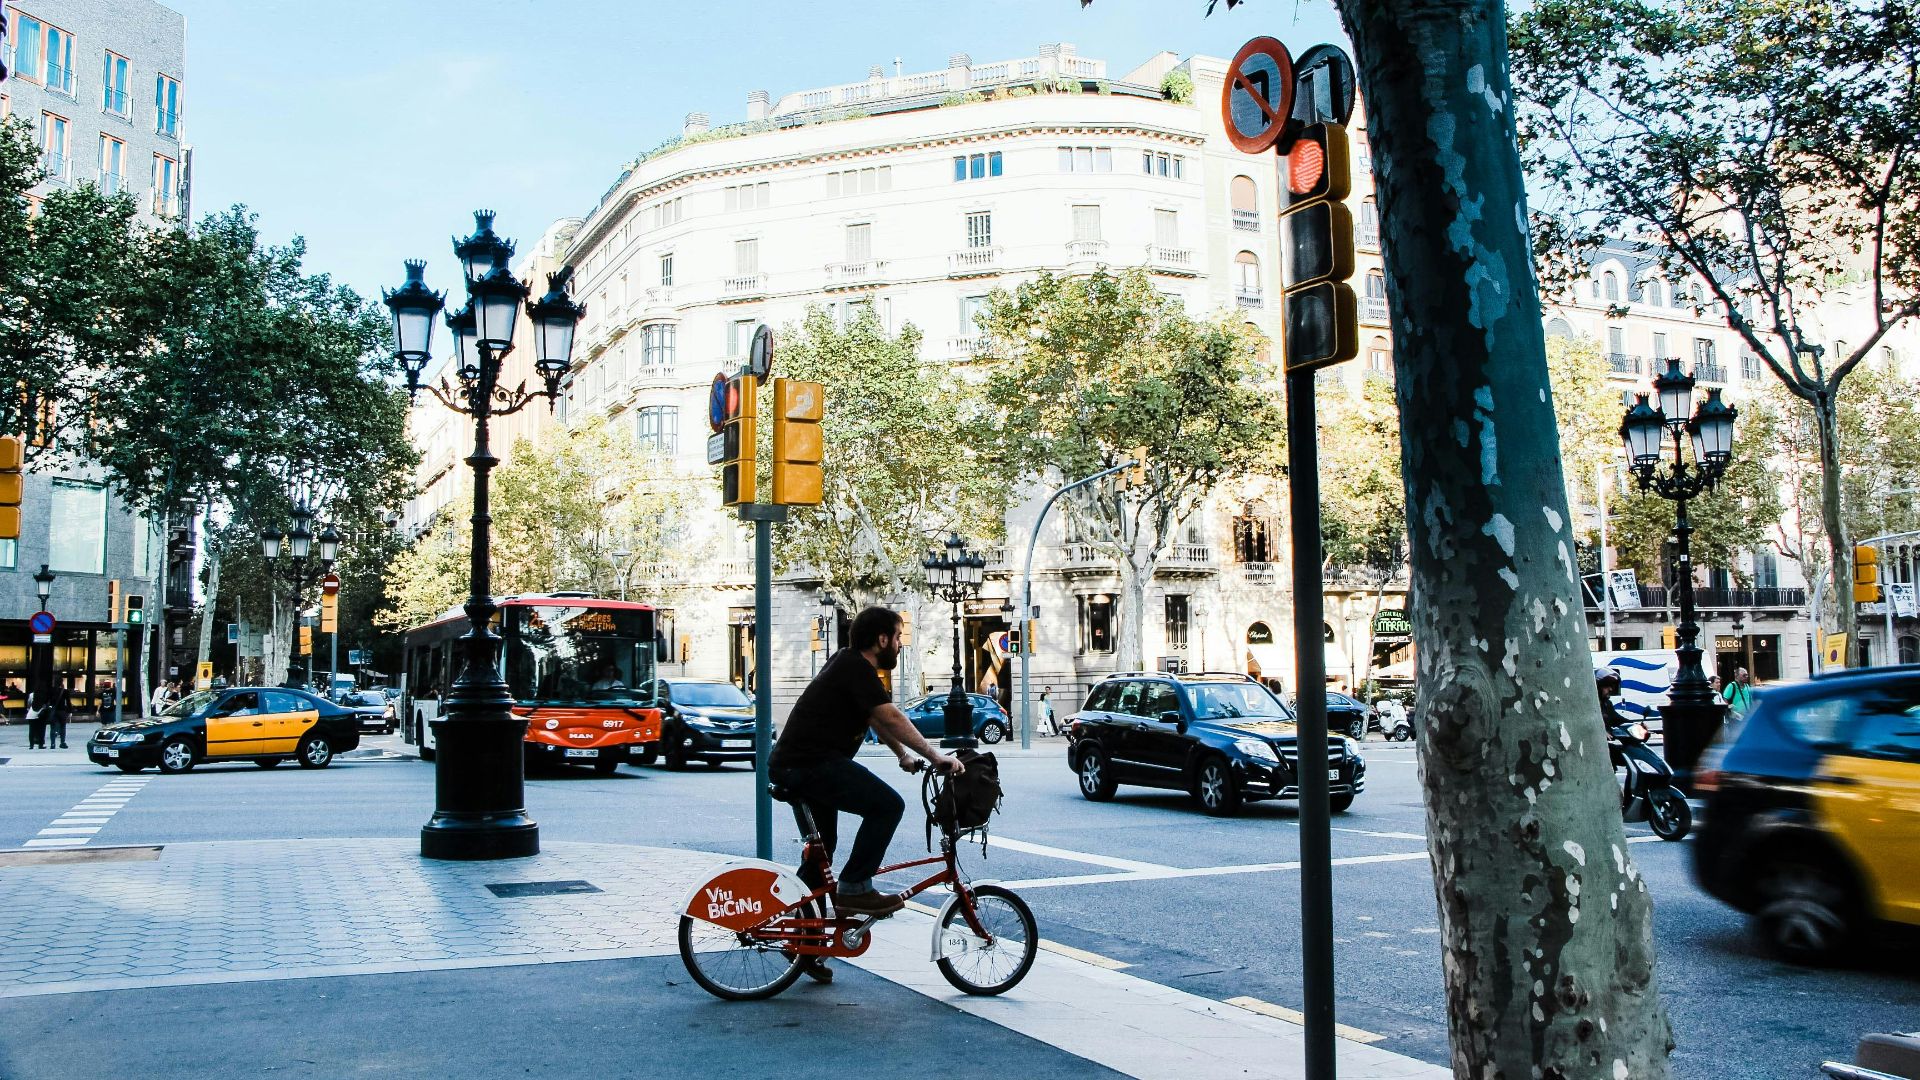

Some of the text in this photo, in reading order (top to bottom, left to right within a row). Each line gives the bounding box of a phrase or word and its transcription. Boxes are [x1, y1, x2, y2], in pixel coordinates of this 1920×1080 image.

[1715, 640, 1742, 648] GUCCI
[602, 720, 624, 728] 6917
[705, 886, 733, 902] Viu
[707, 897, 763, 919] BiCiNg
